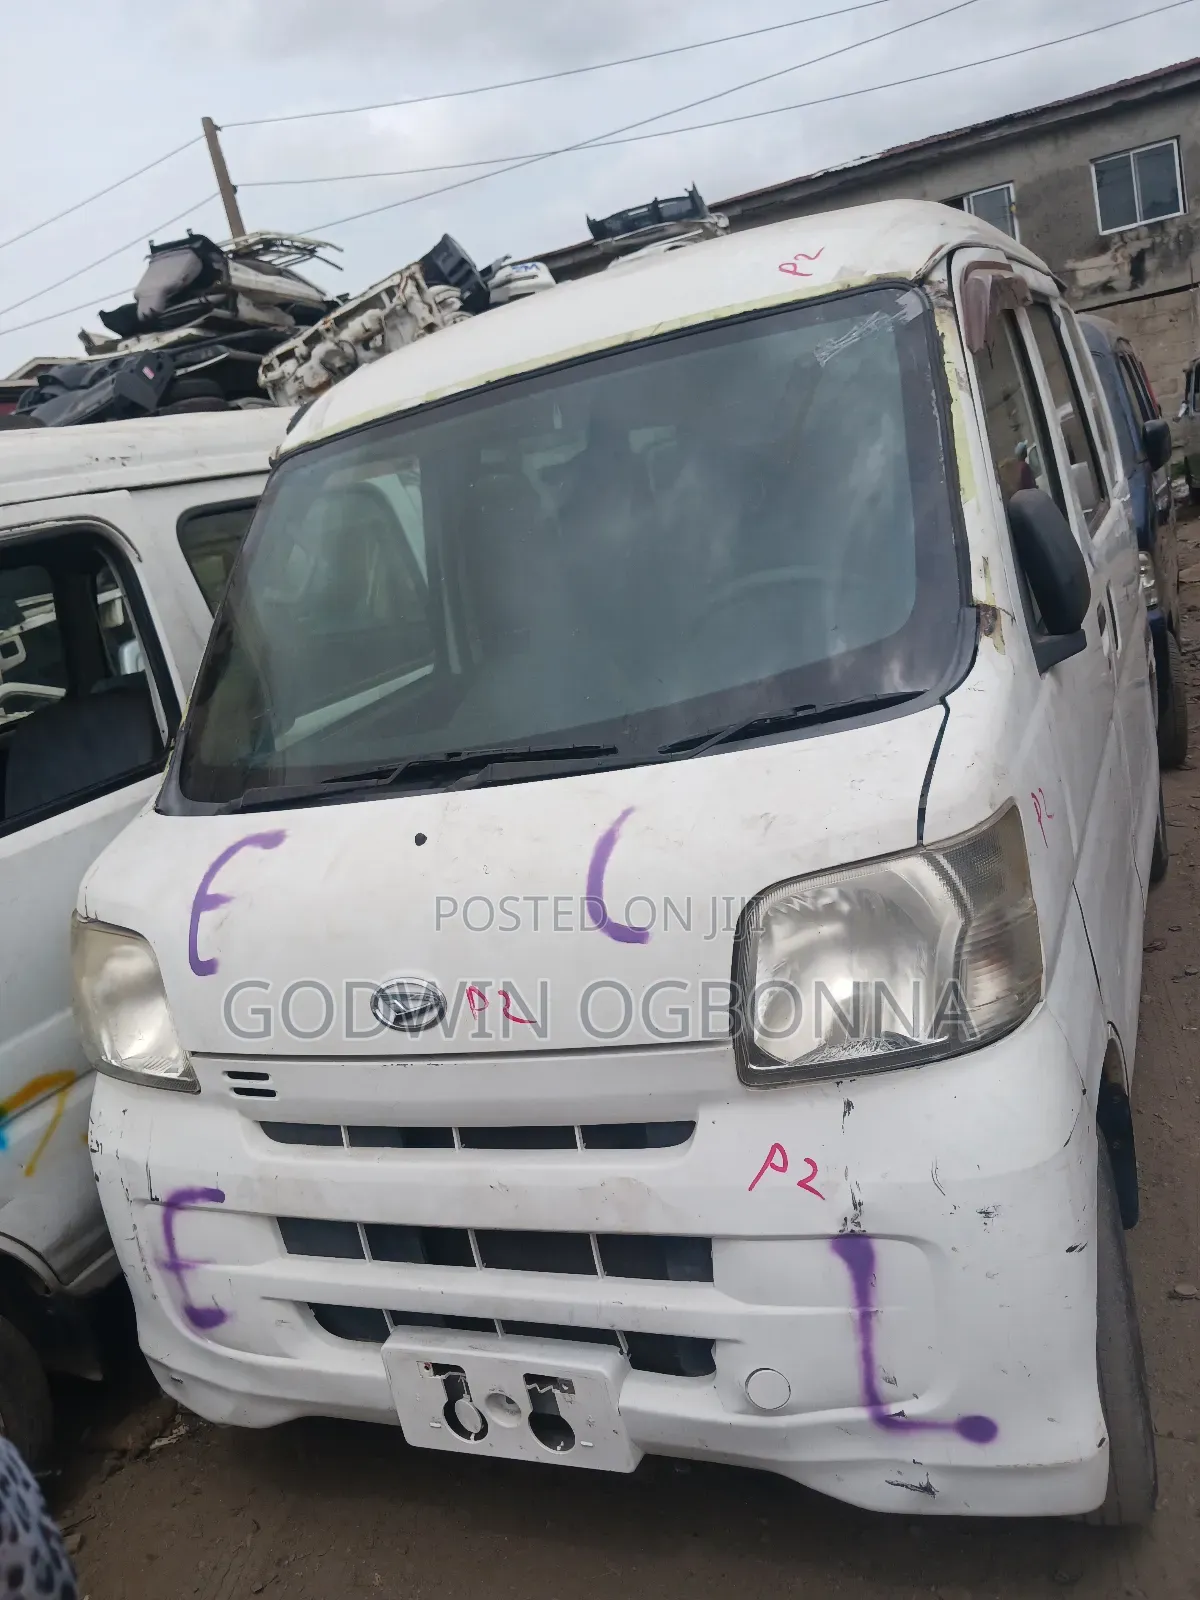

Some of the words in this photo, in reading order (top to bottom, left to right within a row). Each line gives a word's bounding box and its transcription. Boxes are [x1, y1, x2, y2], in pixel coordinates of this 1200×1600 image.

[465, 985, 537, 1024] P2
[748, 1142, 825, 1200] P2
[829, 1233, 999, 1444] L
